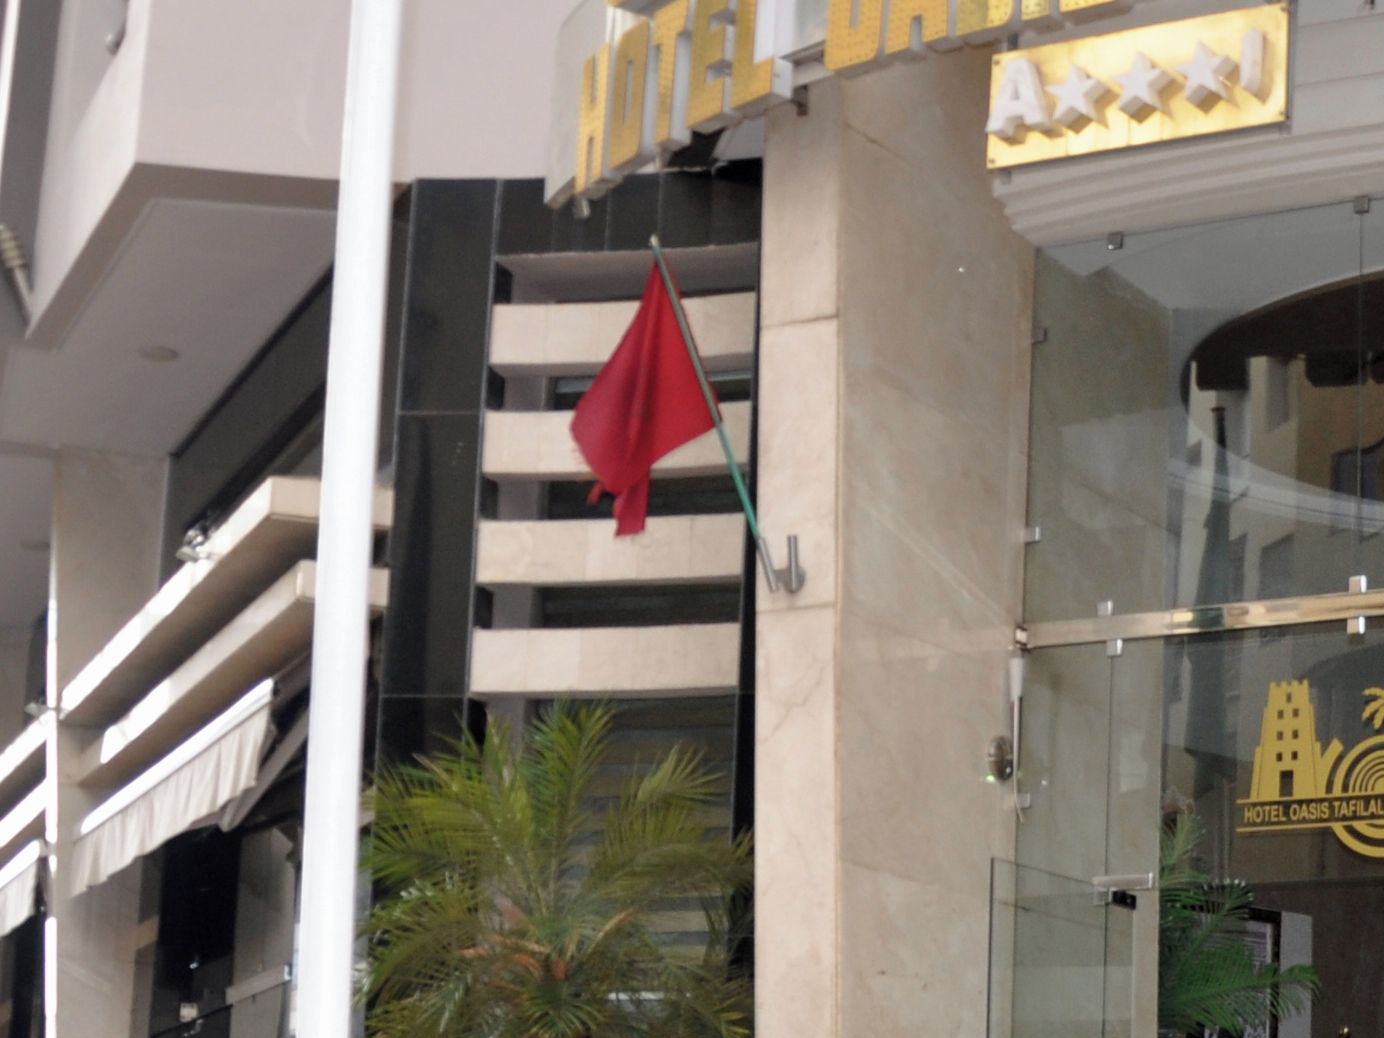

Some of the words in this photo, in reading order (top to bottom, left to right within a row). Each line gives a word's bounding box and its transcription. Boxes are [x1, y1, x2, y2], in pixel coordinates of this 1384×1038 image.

[574, 0, 775, 195] HOTEL
[984, 56, 1055, 138] A
[1244, 804, 1287, 824] HOTEL
[1289, 802, 1329, 820] OASIS
